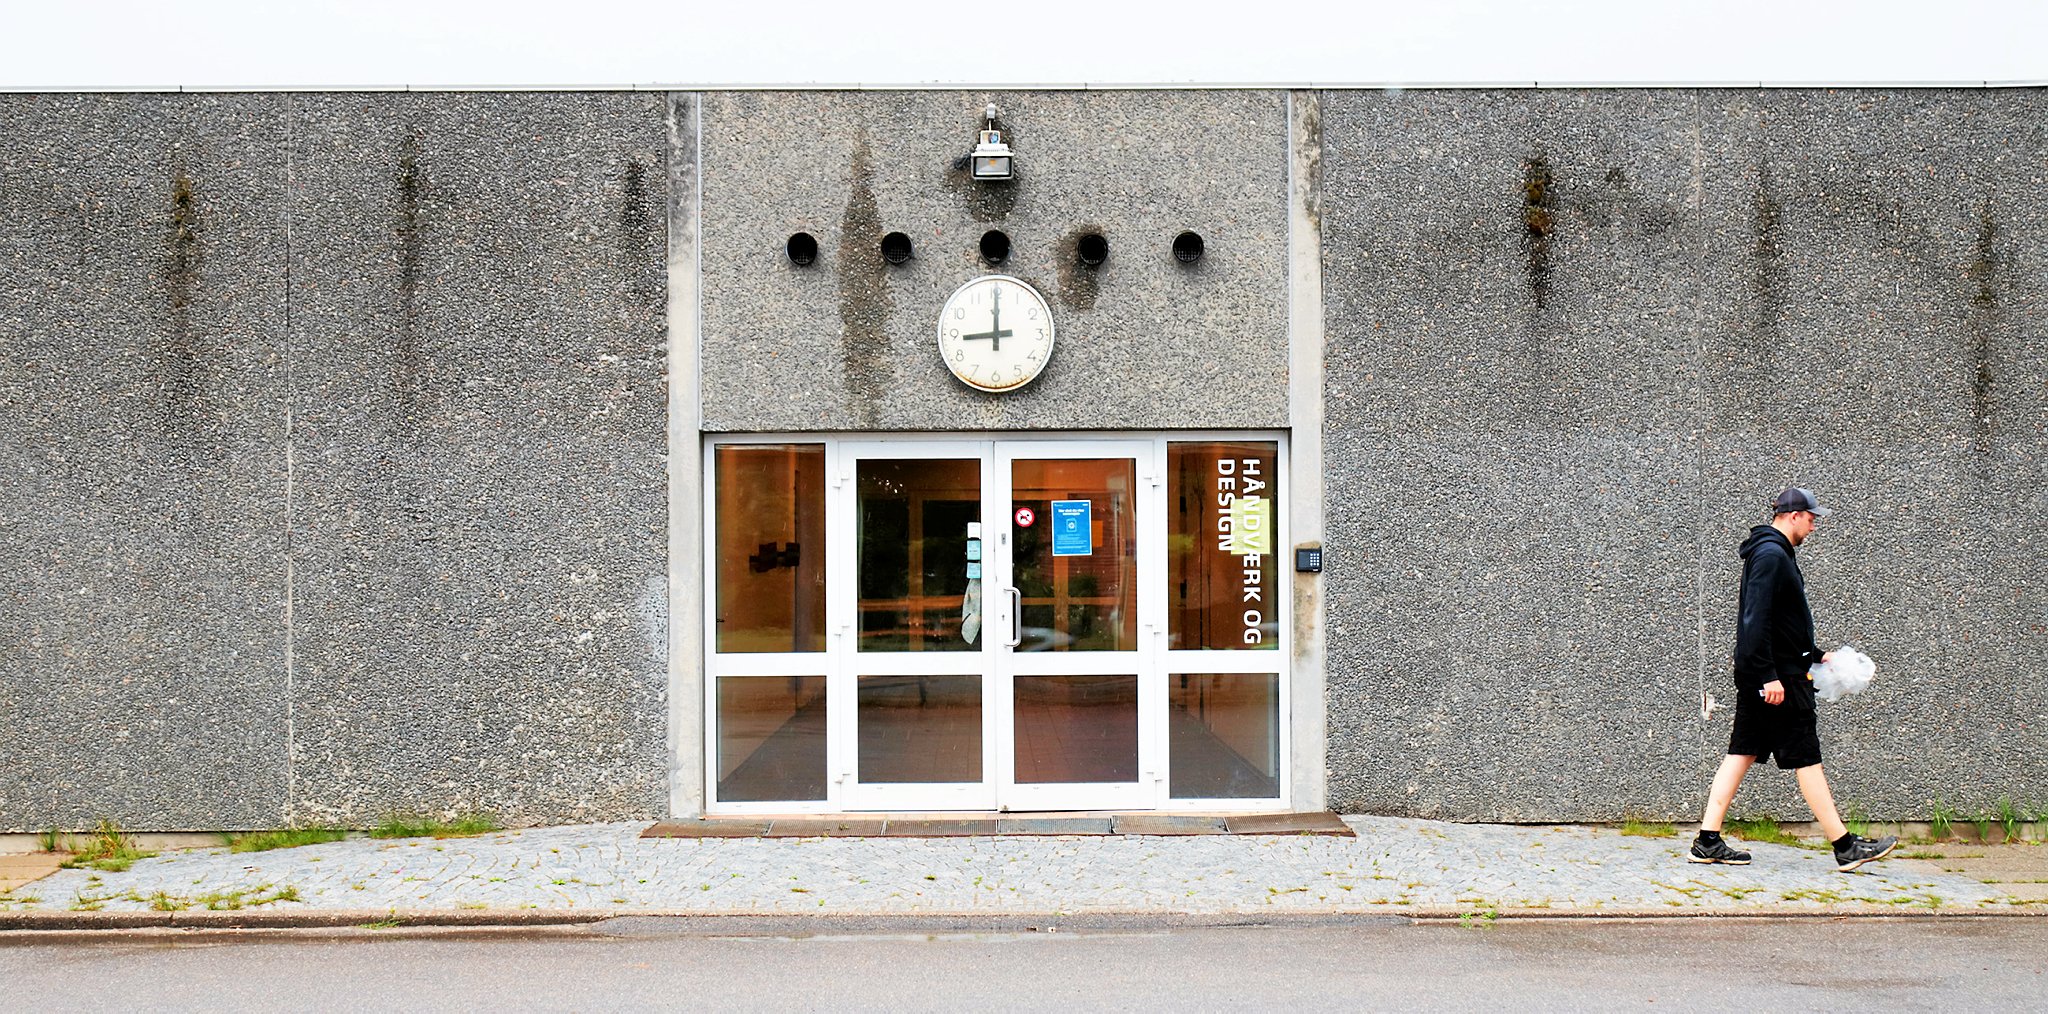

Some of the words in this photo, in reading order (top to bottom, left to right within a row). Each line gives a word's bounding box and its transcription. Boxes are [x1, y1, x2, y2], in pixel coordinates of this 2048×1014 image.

[970, 292, 981, 305] 11
[954, 307, 965, 320] 10
[1028, 307, 1038, 321] 2
[949, 328, 959, 341] 9
[1035, 328, 1044, 341] 3
[955, 349, 965, 362] 8
[1027, 350, 1036, 362] 4
[970, 364, 980, 377] 7
[991, 370, 1001, 382] 6
[1013, 364, 1022, 377] 5
[1217, 458, 1236, 552] DESIGN
[1242, 458, 1266, 603] HÅNDVÆRK
[1243, 609, 1262, 645] OG
